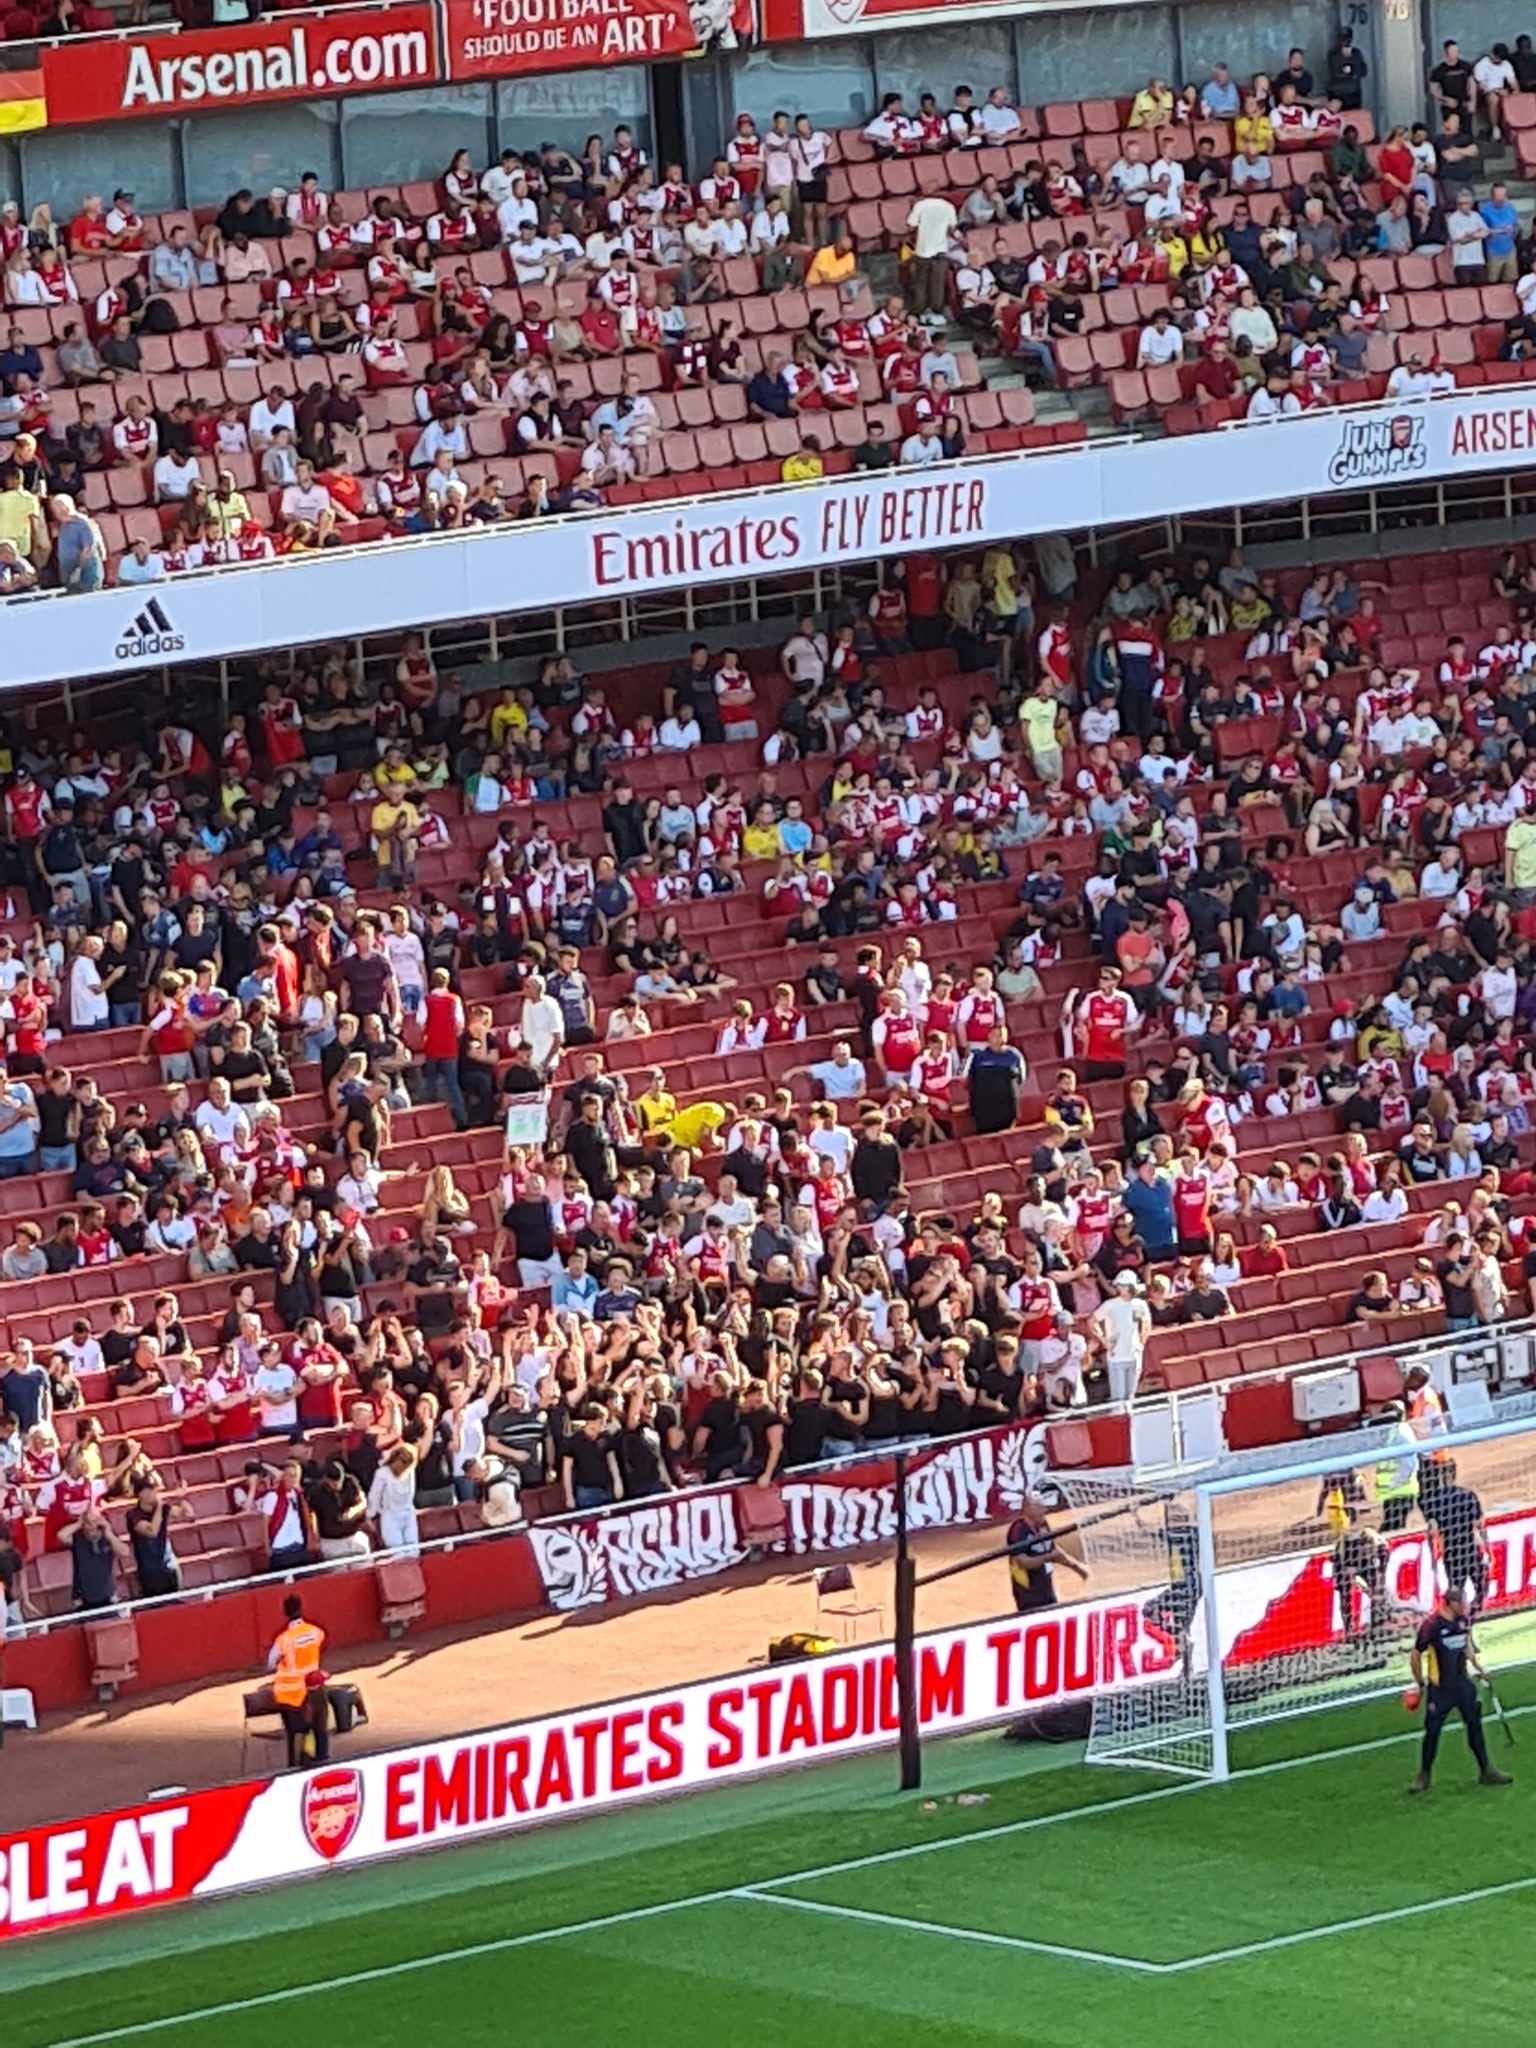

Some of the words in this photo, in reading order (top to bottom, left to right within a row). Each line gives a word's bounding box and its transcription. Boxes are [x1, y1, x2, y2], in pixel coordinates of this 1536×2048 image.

[121, 27, 427, 108] Arsenal.com
[464, 34, 540, 60] SHOULD
[543, 27, 567, 50] BE
[571, 24, 598, 48] AN
[592, 514, 801, 587] Emirates
[821, 494, 870, 553] FLY
[880, 479, 985, 544] BETTER
[115, 634, 185, 659] adidas
[384, 1700, 685, 1842] EMIRATES
[987, 1599, 1176, 1707] TOURS
[0, 1829, 89, 1926] LE
[97, 1806, 190, 1905] AT
